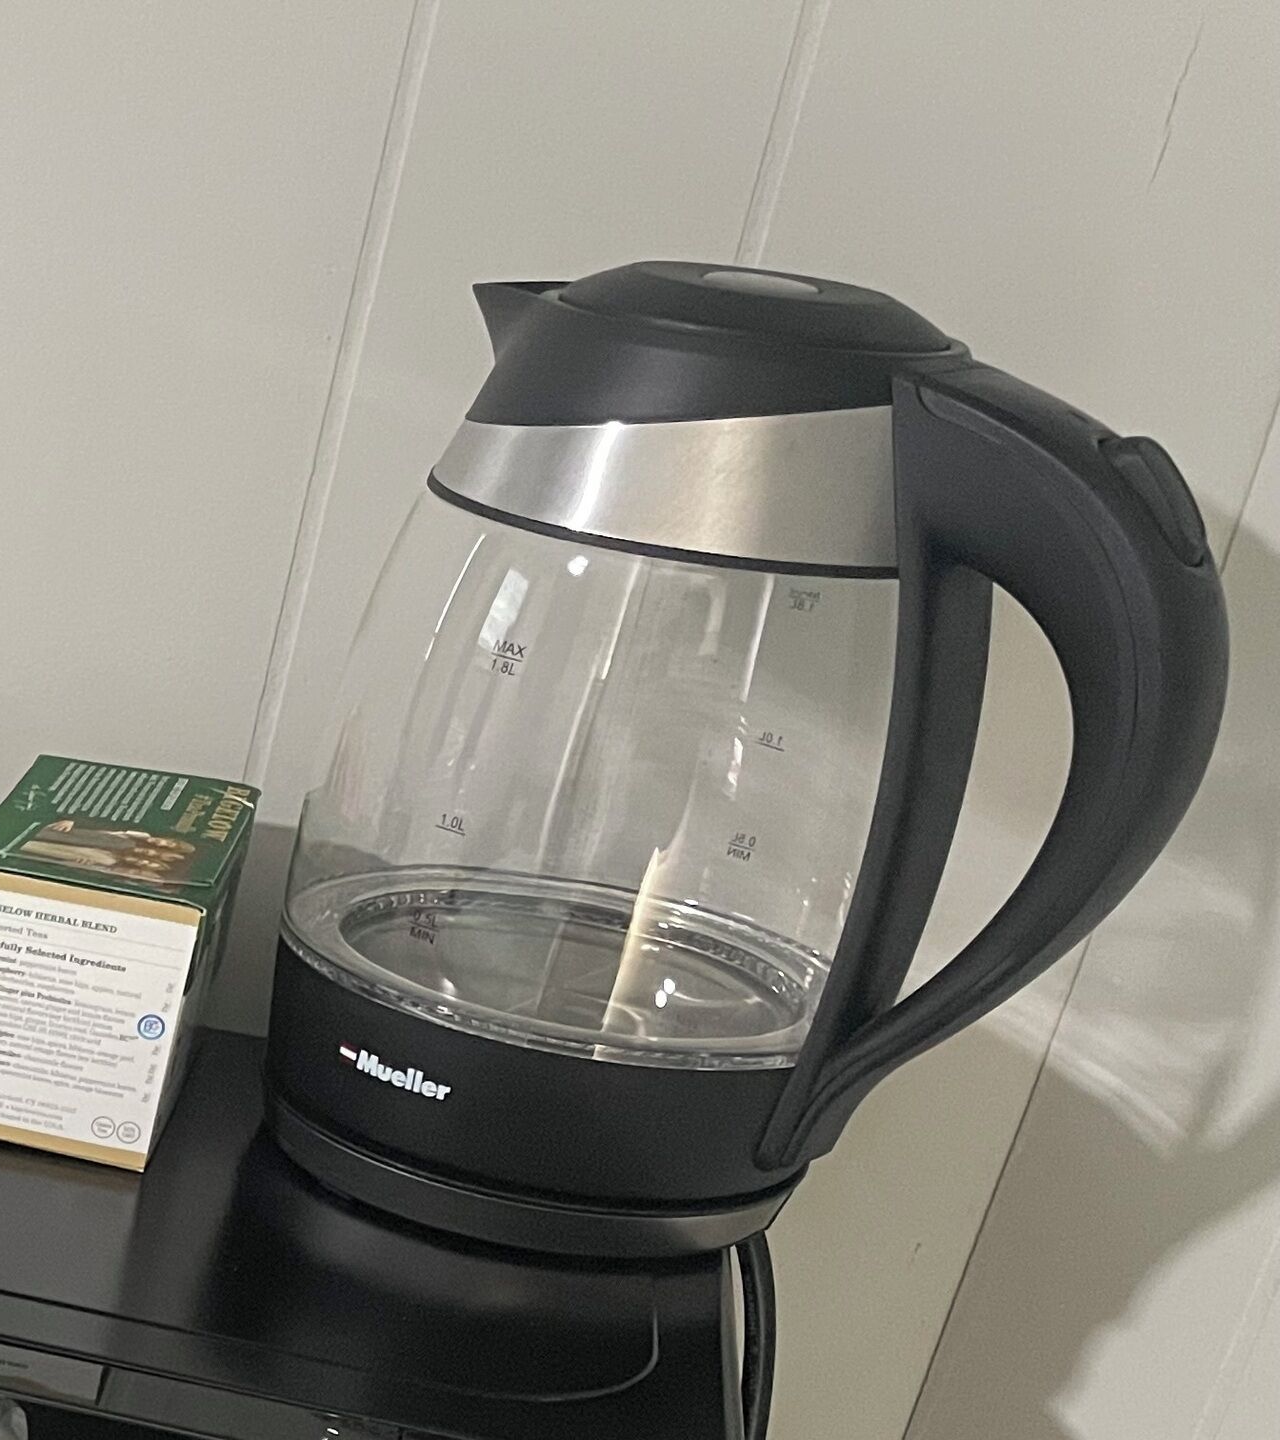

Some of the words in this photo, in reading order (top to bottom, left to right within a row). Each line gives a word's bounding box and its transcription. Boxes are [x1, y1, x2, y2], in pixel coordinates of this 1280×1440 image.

[493, 640, 527, 658] MAX
[441, 813, 464, 832] 1.0L
[35, 911, 80, 927] HERBAL
[81, 920, 118, 934] BLEND
[25, 946, 67, 961] Selected
[69, 954, 127, 973] Ingredients
[356, 1049, 451, 1100] Mueller
